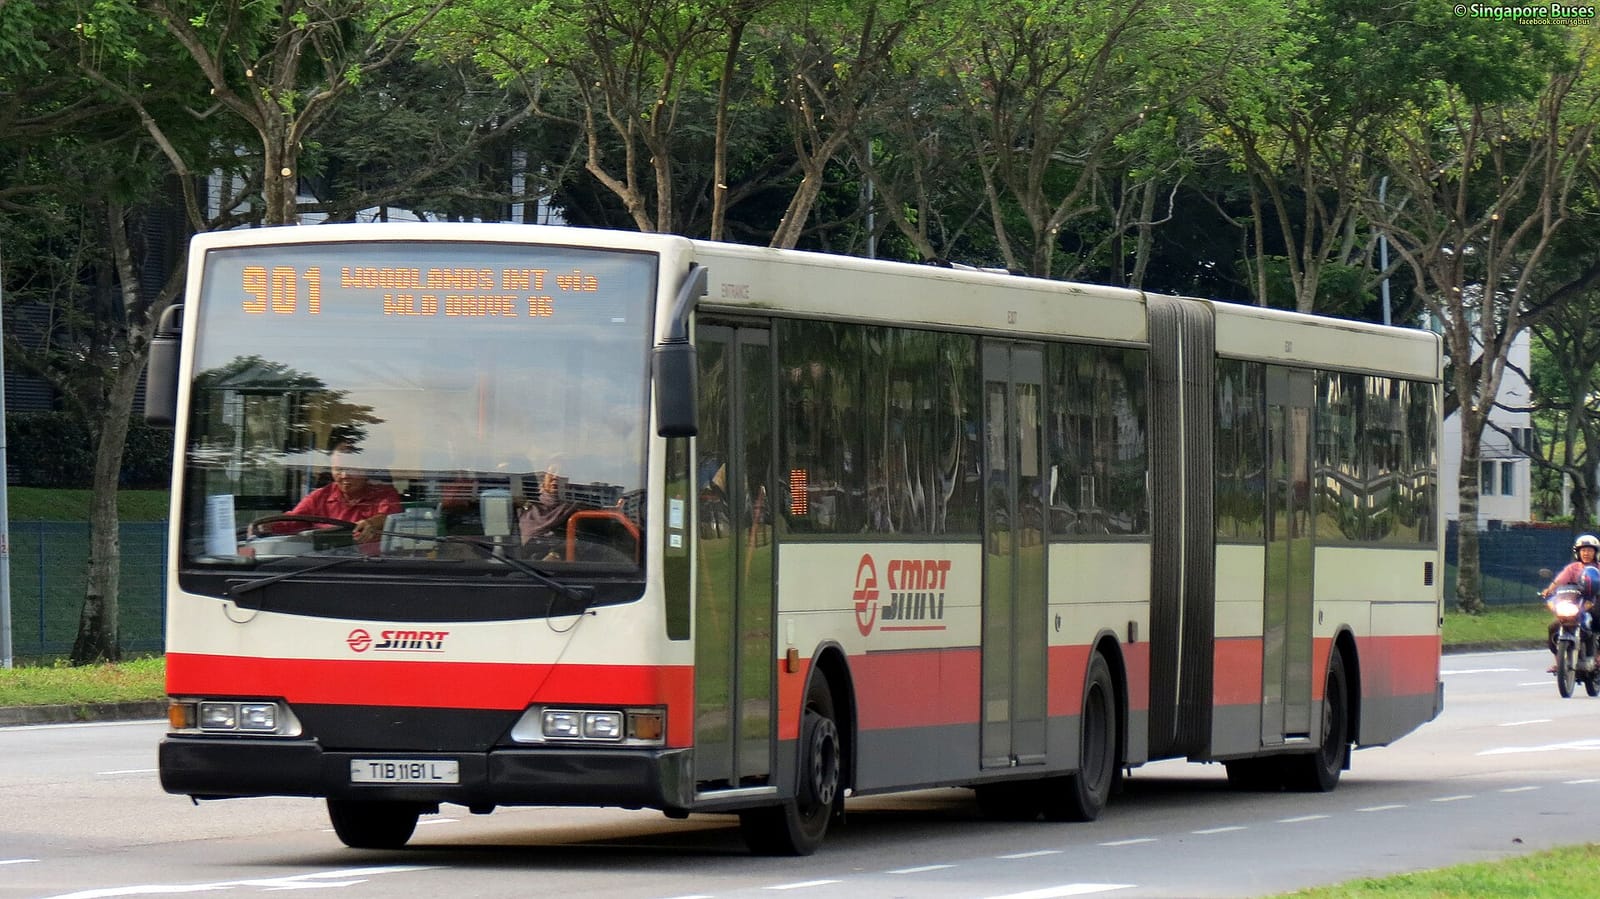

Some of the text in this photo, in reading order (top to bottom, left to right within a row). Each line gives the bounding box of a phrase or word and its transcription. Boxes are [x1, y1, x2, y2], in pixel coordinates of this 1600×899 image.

[242, 265, 598, 315] 901 WOODLANDS INT via
[383, 293, 553, 318] WLD DRIVE 16
[881, 559, 951, 620] SMRT
[375, 630, 449, 650] SMRT
